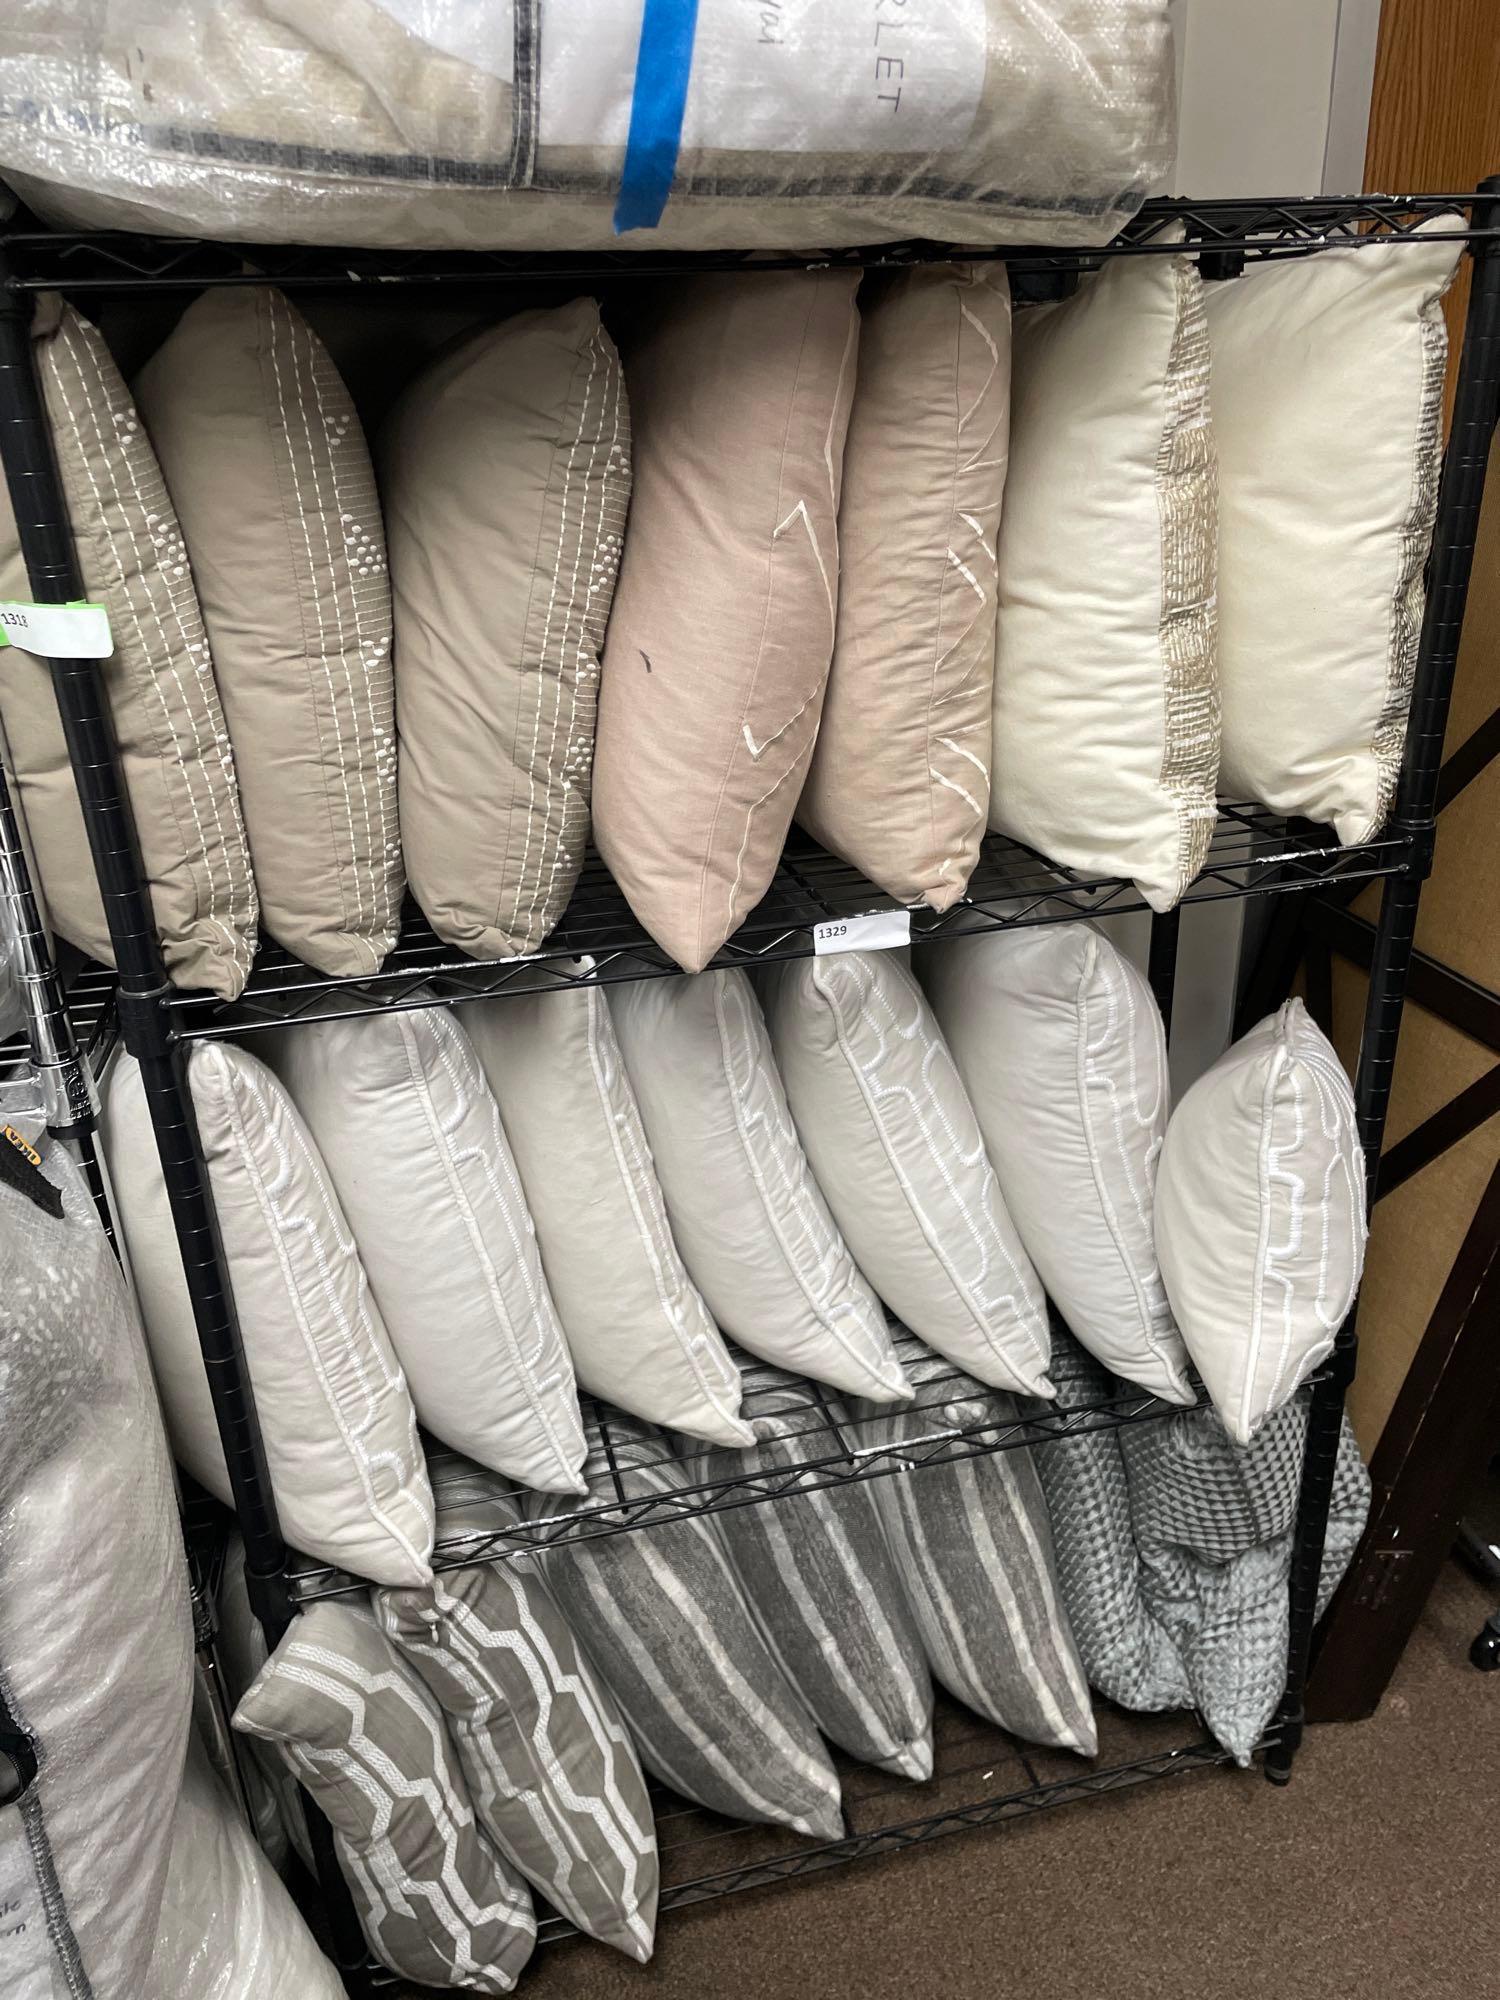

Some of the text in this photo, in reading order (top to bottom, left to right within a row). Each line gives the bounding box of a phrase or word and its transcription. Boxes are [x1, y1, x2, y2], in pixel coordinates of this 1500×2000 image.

[1, 613, 28, 628] 1318
[818, 925, 847, 939] 1329
[9, 1130, 37, 1161] IKEA
